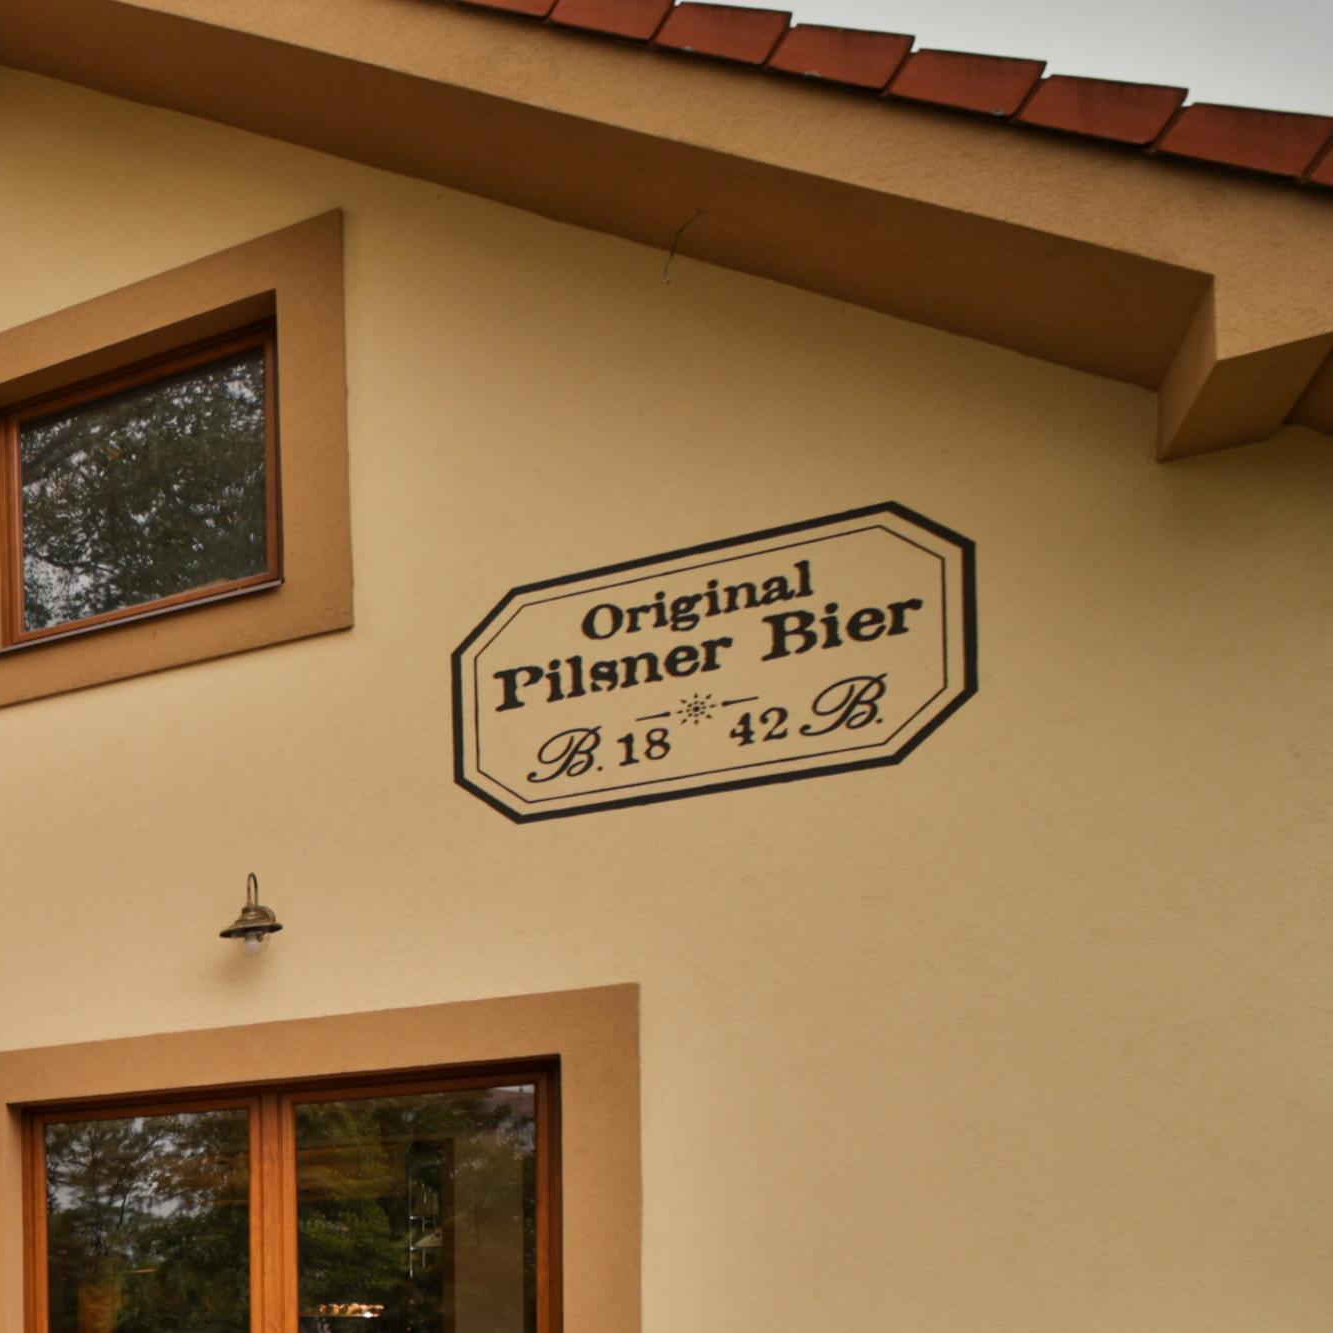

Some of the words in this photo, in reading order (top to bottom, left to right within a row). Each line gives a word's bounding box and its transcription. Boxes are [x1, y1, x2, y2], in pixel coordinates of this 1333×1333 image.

[580, 559, 814, 640] Original
[492, 635, 734, 713] Pilsner
[759, 597, 924, 662] Bier
[615, 727, 672, 767] 18
[728, 706, 790, 747] 42
